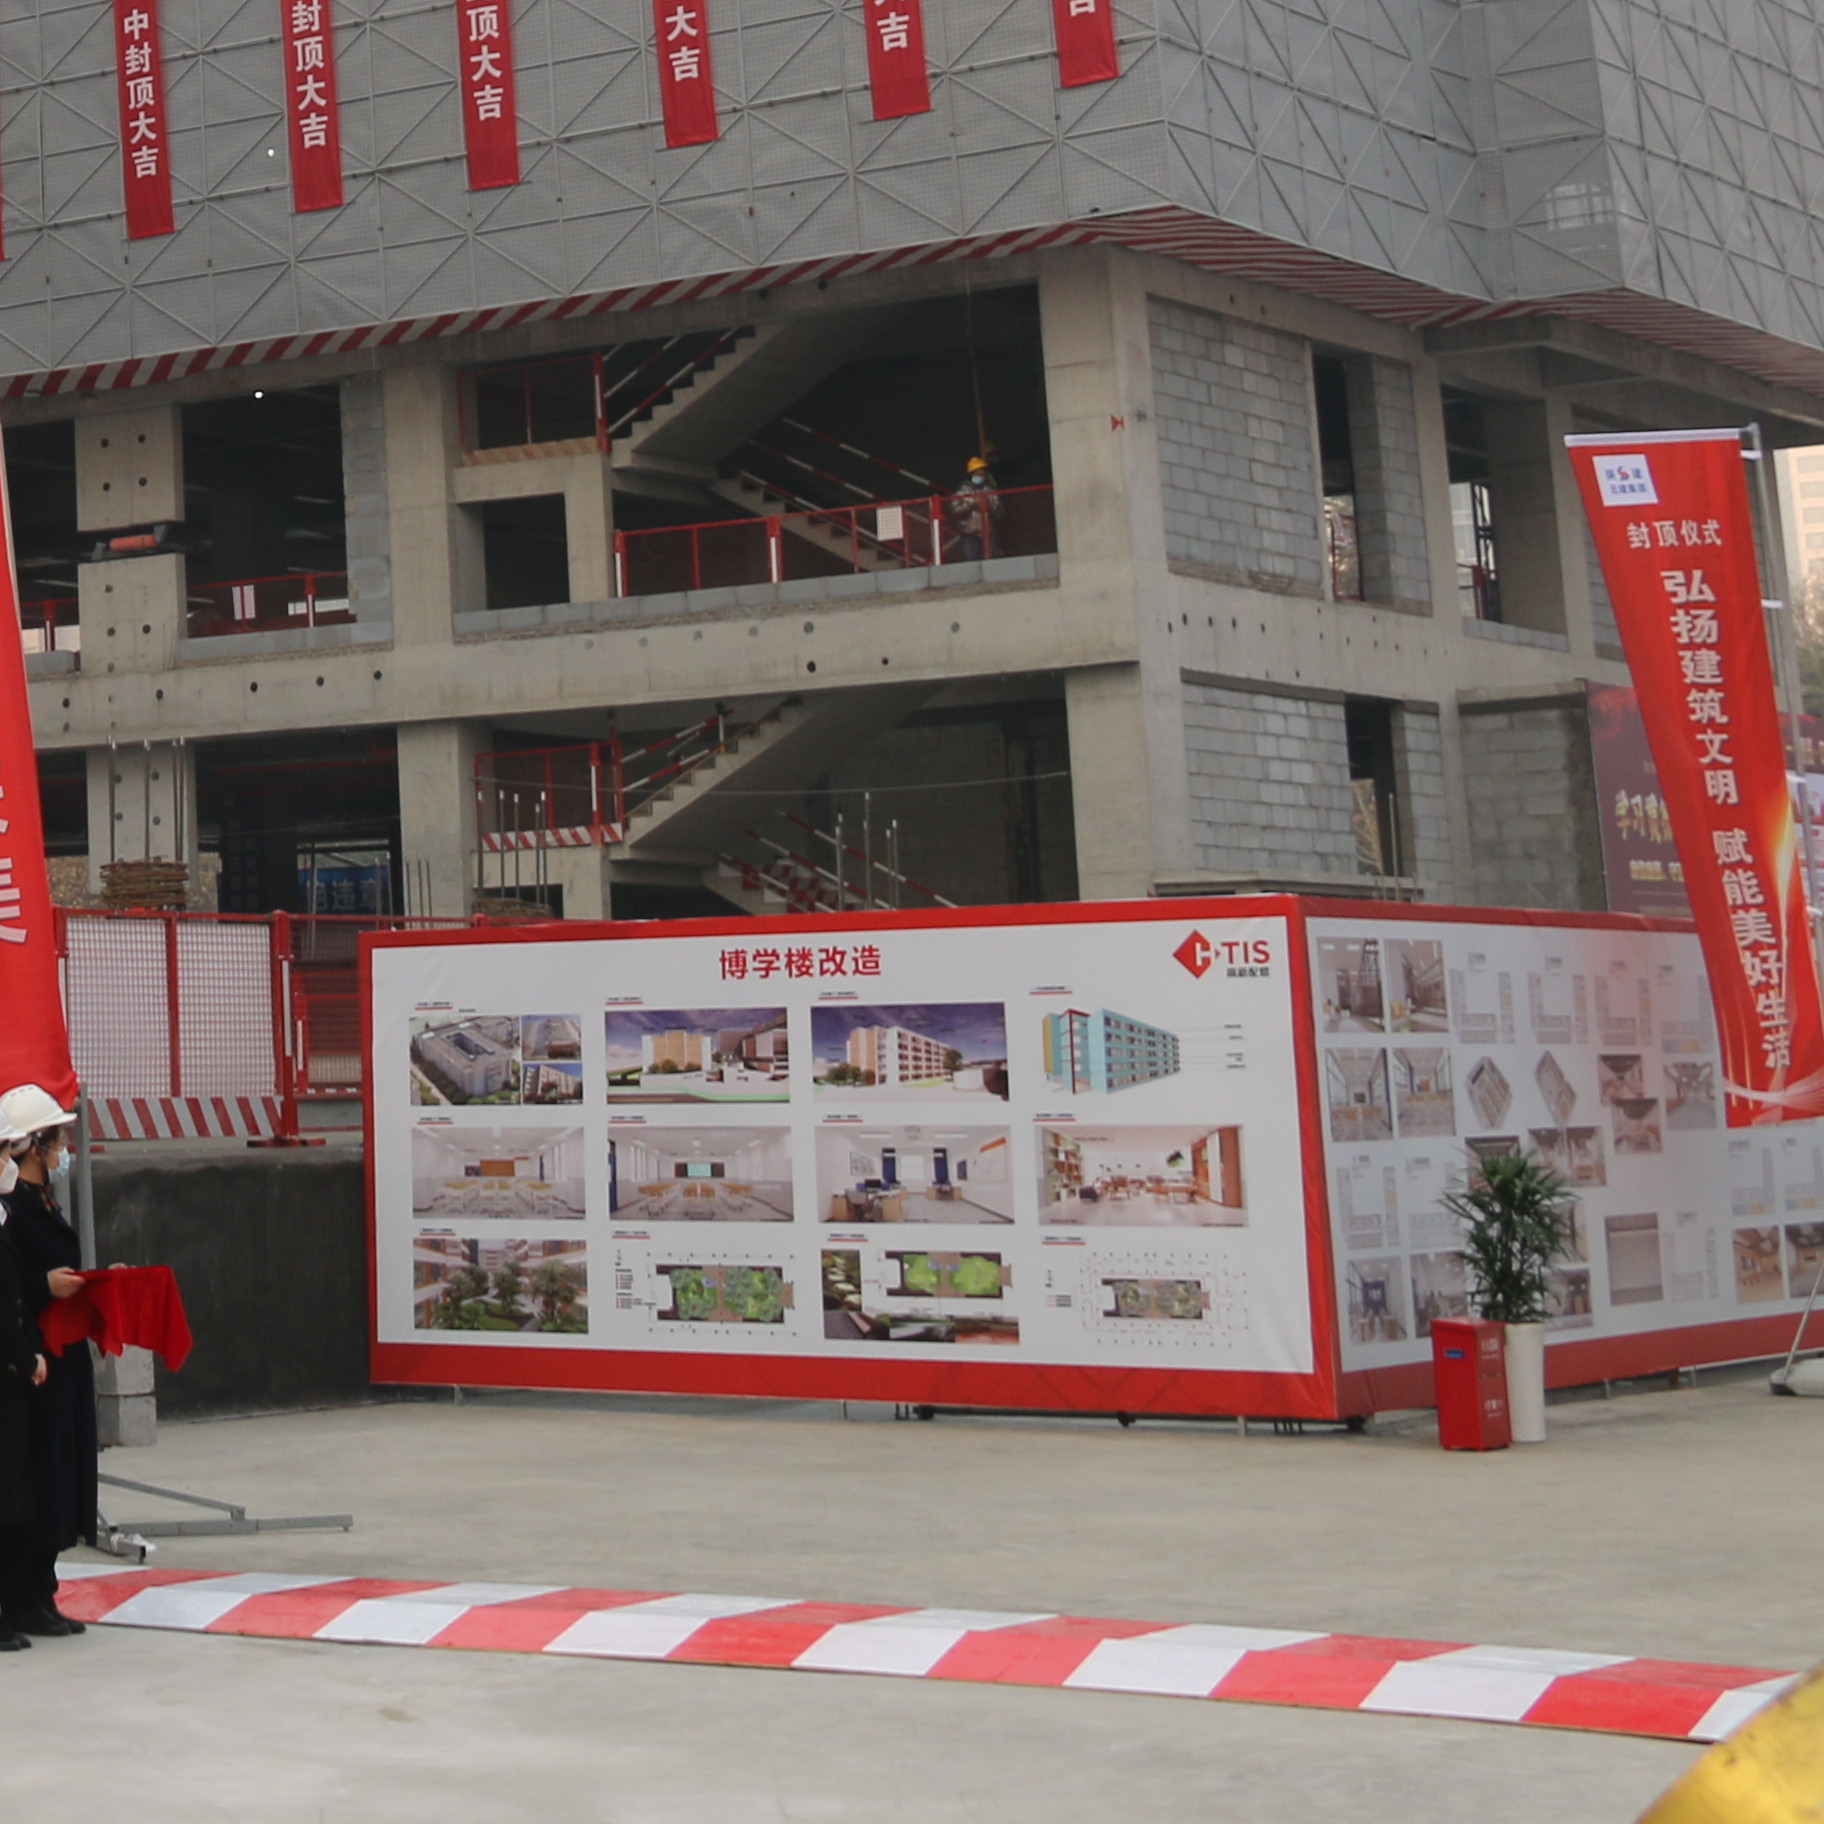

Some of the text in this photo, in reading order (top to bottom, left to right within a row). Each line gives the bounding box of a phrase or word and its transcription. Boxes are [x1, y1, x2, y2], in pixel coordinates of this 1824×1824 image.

[1626, 518, 1723, 550] 封顶仪式
[1661, 568, 1791, 1070] 弘扬建筑文明 赋能美好生活
[717, 944, 883, 981] 博学楼改造
